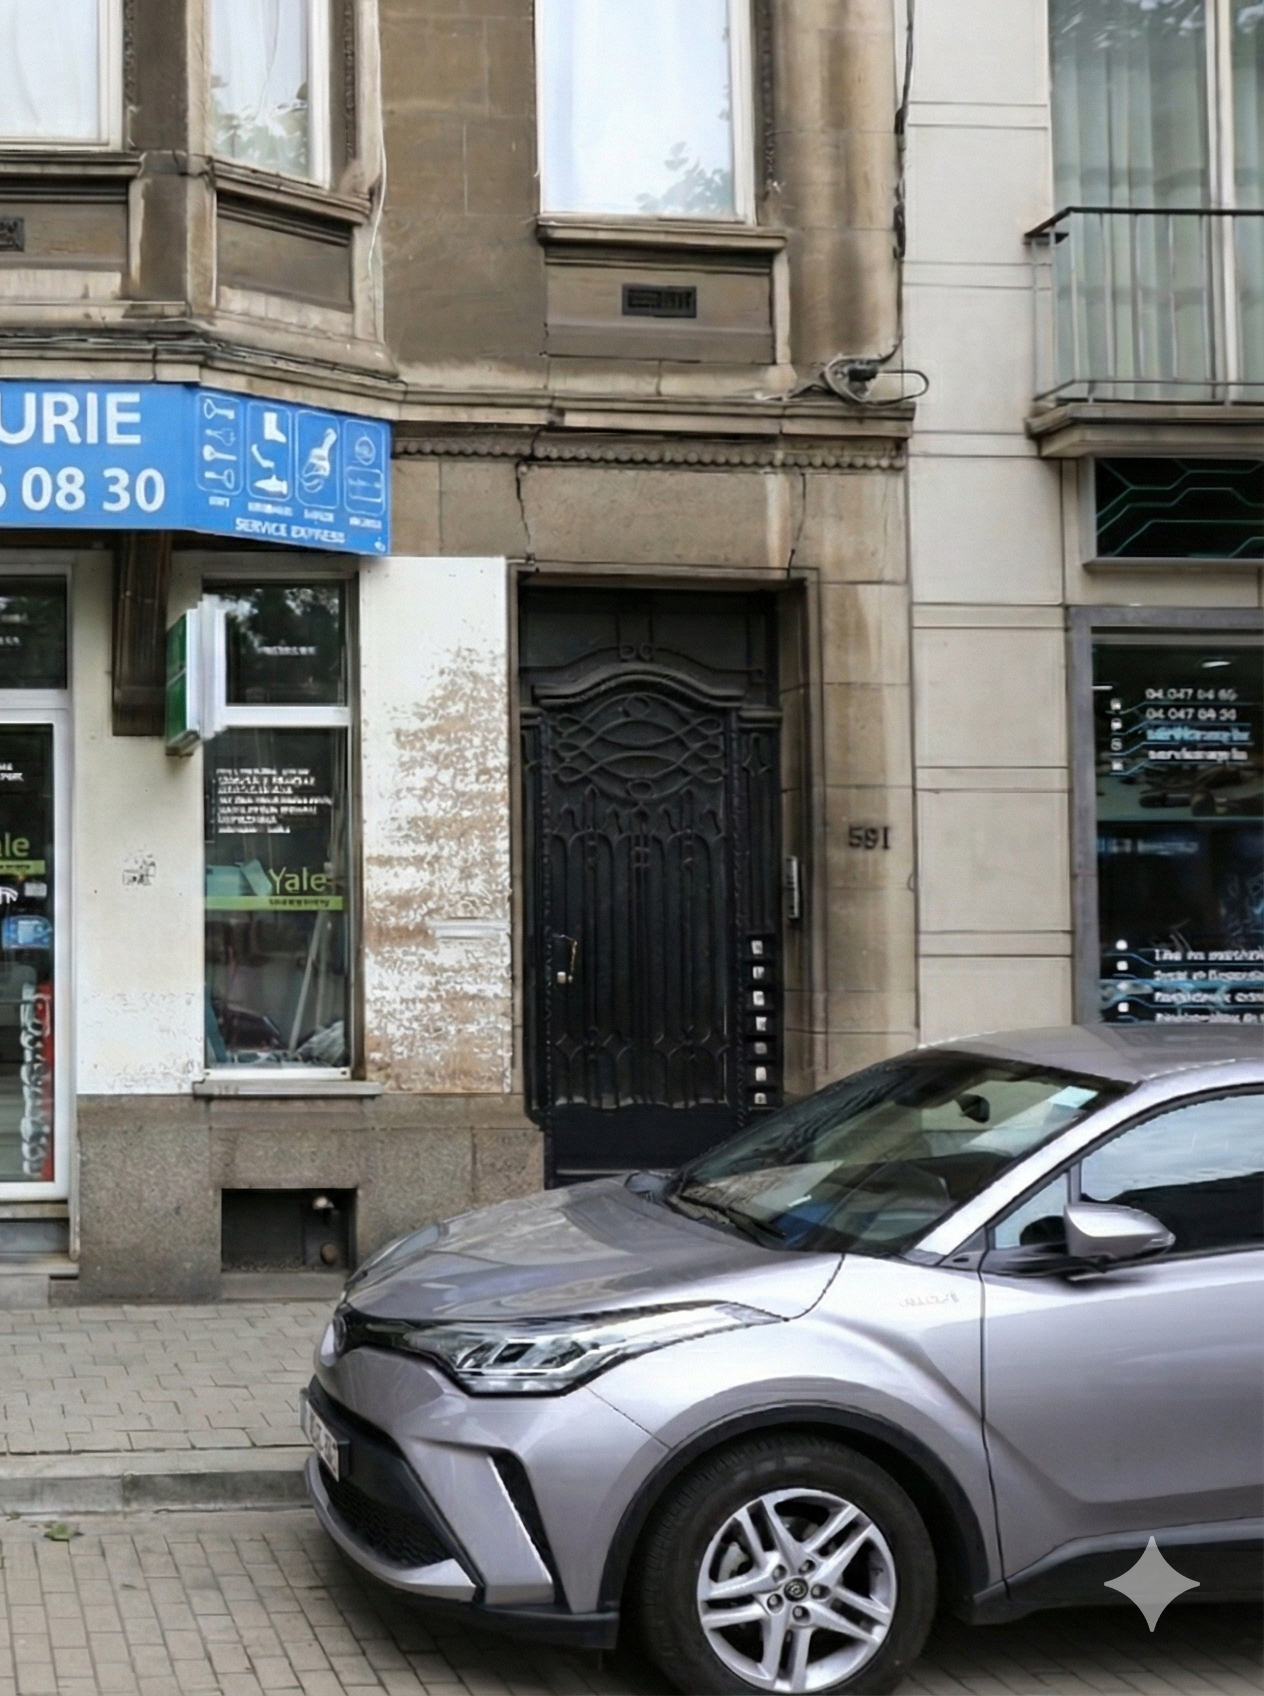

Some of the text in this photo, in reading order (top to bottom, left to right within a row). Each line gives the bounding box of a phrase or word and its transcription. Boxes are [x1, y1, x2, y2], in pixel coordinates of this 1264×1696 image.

[21, 466, 86, 512] 08
[102, 467, 165, 512] 30
[235, 517, 287, 538] SERVICE
[848, 826, 890, 850] 591
[268, 866, 327, 894] Yale
